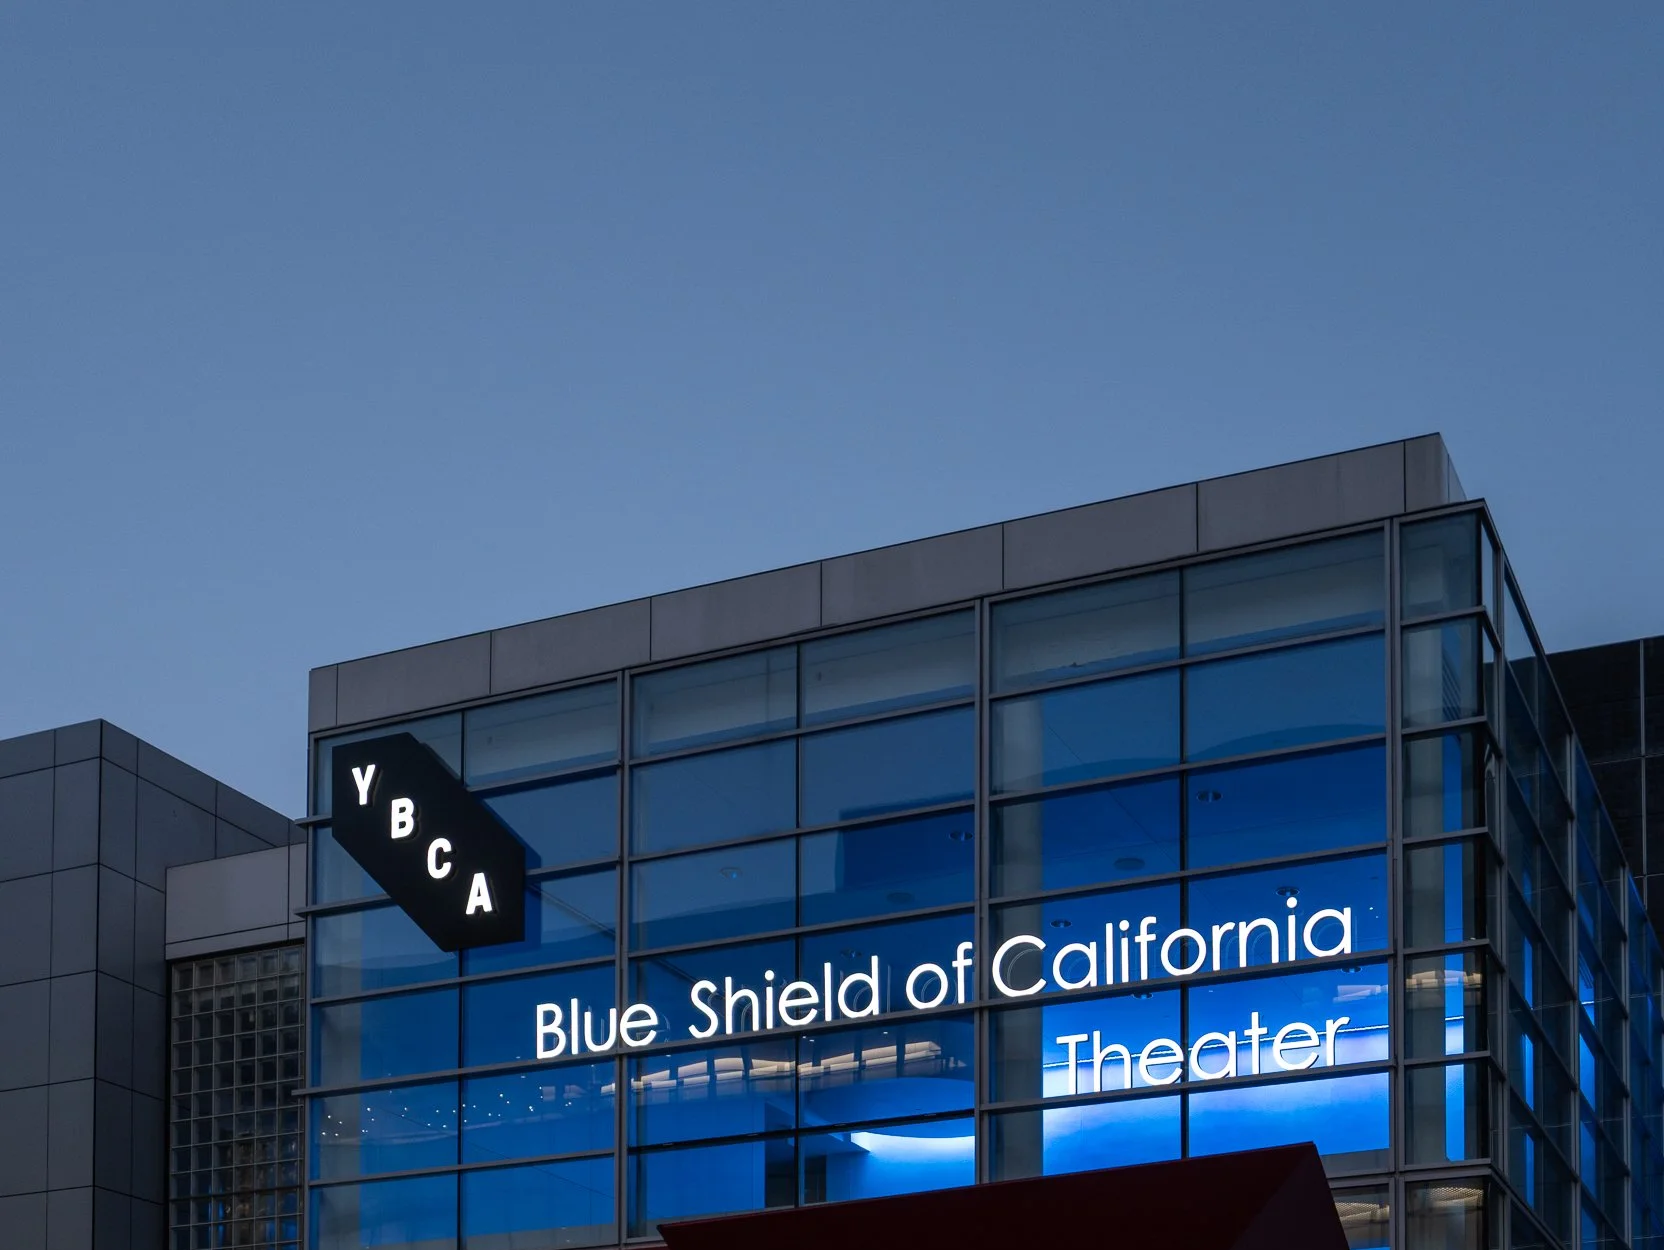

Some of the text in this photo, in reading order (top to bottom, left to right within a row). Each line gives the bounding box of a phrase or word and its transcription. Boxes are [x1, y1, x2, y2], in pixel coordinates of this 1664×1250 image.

[350, 763, 494, 916] YBCA
[535, 895, 1353, 1061] Blue Shield of California
[1055, 1011, 1351, 1096] Theater
